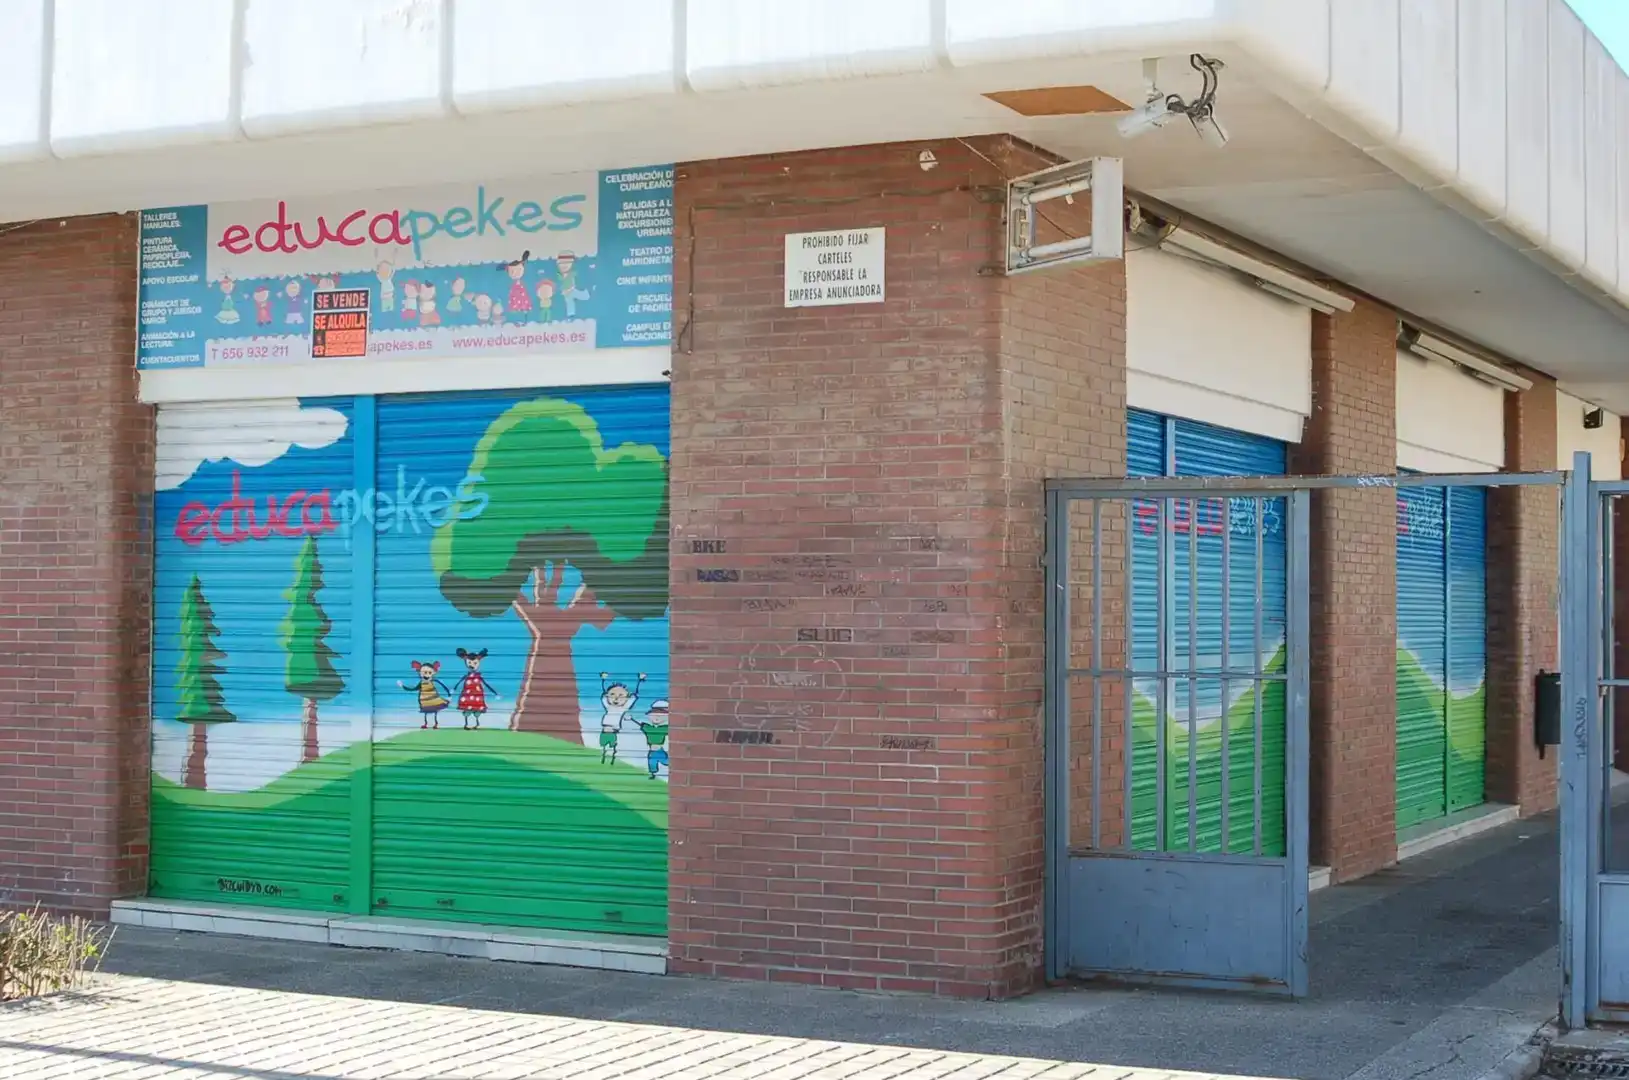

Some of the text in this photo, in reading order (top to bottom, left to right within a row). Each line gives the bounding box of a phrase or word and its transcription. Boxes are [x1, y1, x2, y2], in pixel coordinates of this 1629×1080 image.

[605, 170, 664, 184] CELEBRACIÓN
[620, 179, 674, 192] CUMPLEAÑO
[623, 200, 657, 210] SALIDAS
[659, 199, 665, 207] A
[144, 212, 178, 222] TALLERES
[616, 208, 671, 220] NATURALEZA
[618, 218, 673, 230] EXCURSIONE
[802, 232, 869, 249] PROHIBIDO FIJAR
[629, 246, 662, 257] TEATRO
[622, 255, 673, 267] MARIONETA
[818, 251, 853, 265] CARTELES
[143, 275, 199, 285] APOYO ESCOLAR
[616, 274, 672, 286] CINE INFANTI
[803, 267, 867, 284] RESPONSABLE LA
[789, 283, 882, 301] EMPRESA ANUNCIADORA
[316, 292, 366, 309] SE VENDE
[142, 308, 167, 317] GRUPO
[173, 306, 202, 315] JUEGOS
[628, 302, 672, 313] DE PADRE
[314, 311, 366, 330] SE ALQUILA
[626, 321, 661, 332] CAMPUS
[187, 330, 196, 339] LA
[622, 330, 672, 341] VACACIONE
[212, 347, 218, 361] T
[222, 347, 243, 360] 656
[246, 345, 268, 359] 932
[271, 344, 289, 358] 211
[452, 331, 587, 348] www.educapekes.es
